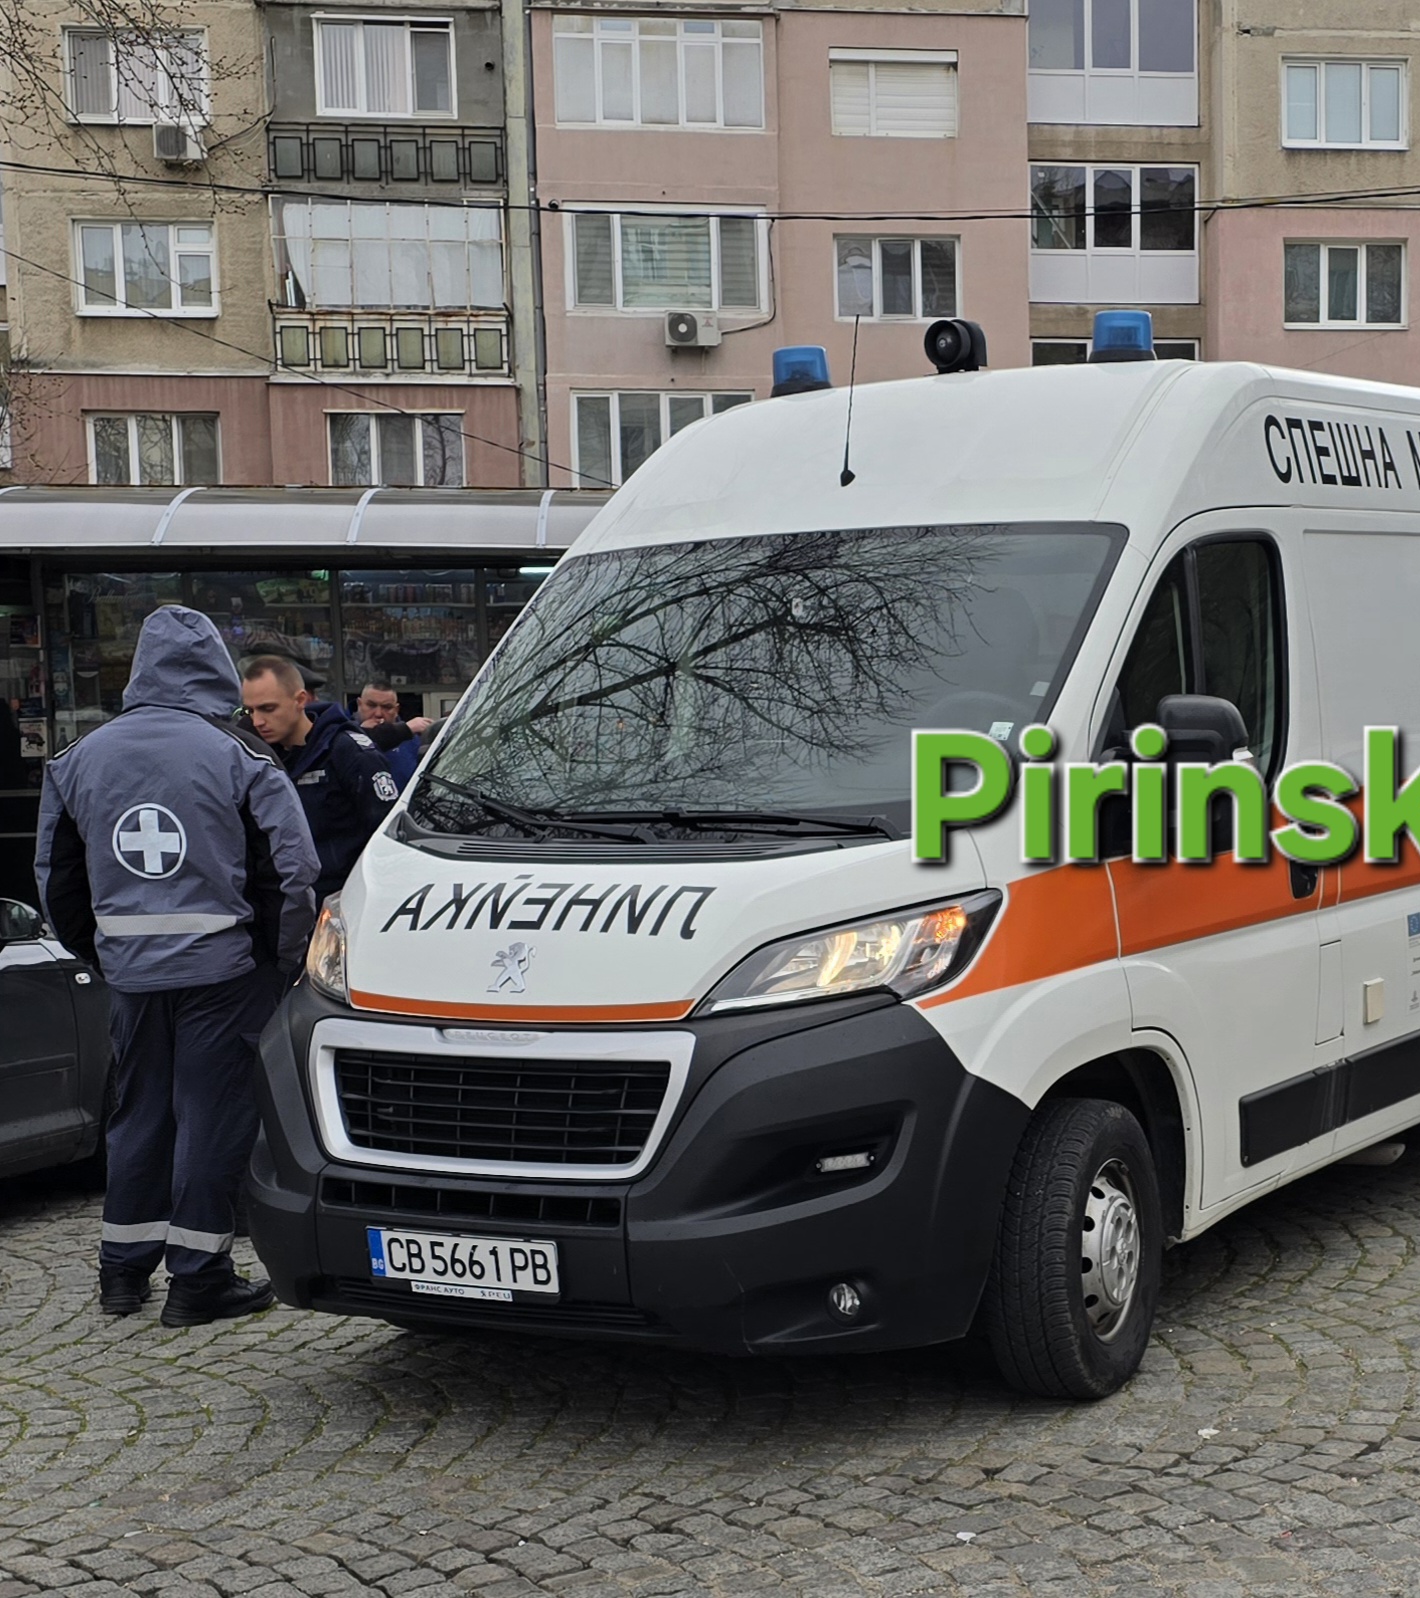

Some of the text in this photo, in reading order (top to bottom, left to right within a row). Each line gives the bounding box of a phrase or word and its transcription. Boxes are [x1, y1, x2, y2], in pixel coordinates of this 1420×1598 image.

[1264, 413, 1403, 489] СПЕШНА
[371, 1258, 384, 1270] BG
[387, 1237, 551, 1286] CB 5661 PB
